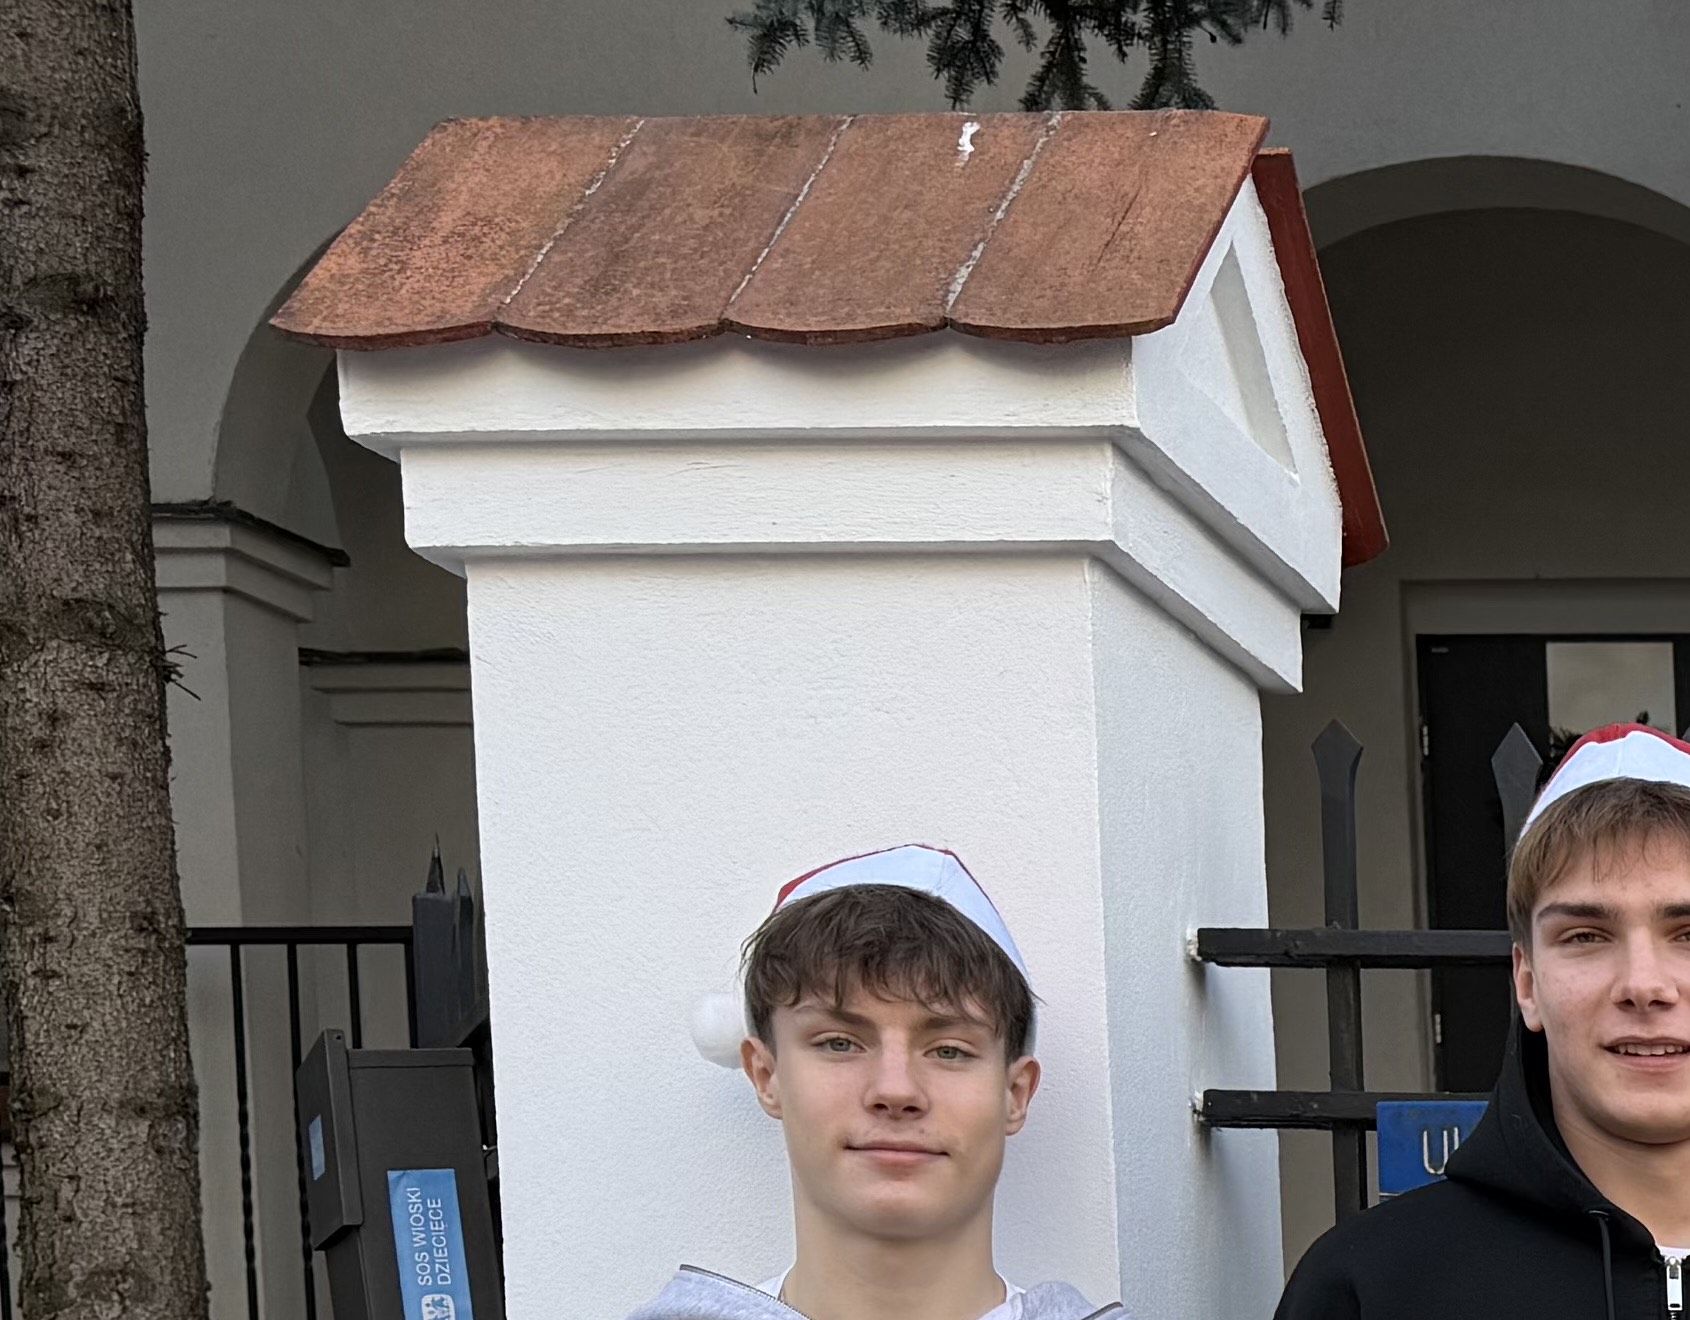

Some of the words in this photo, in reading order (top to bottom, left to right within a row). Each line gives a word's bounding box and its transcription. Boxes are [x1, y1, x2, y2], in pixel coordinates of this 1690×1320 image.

[407, 1187, 427, 1248] WIOSKI
[427, 1198, 451, 1285] DZIECIĘCE
[414, 1252, 432, 1286] SOS
